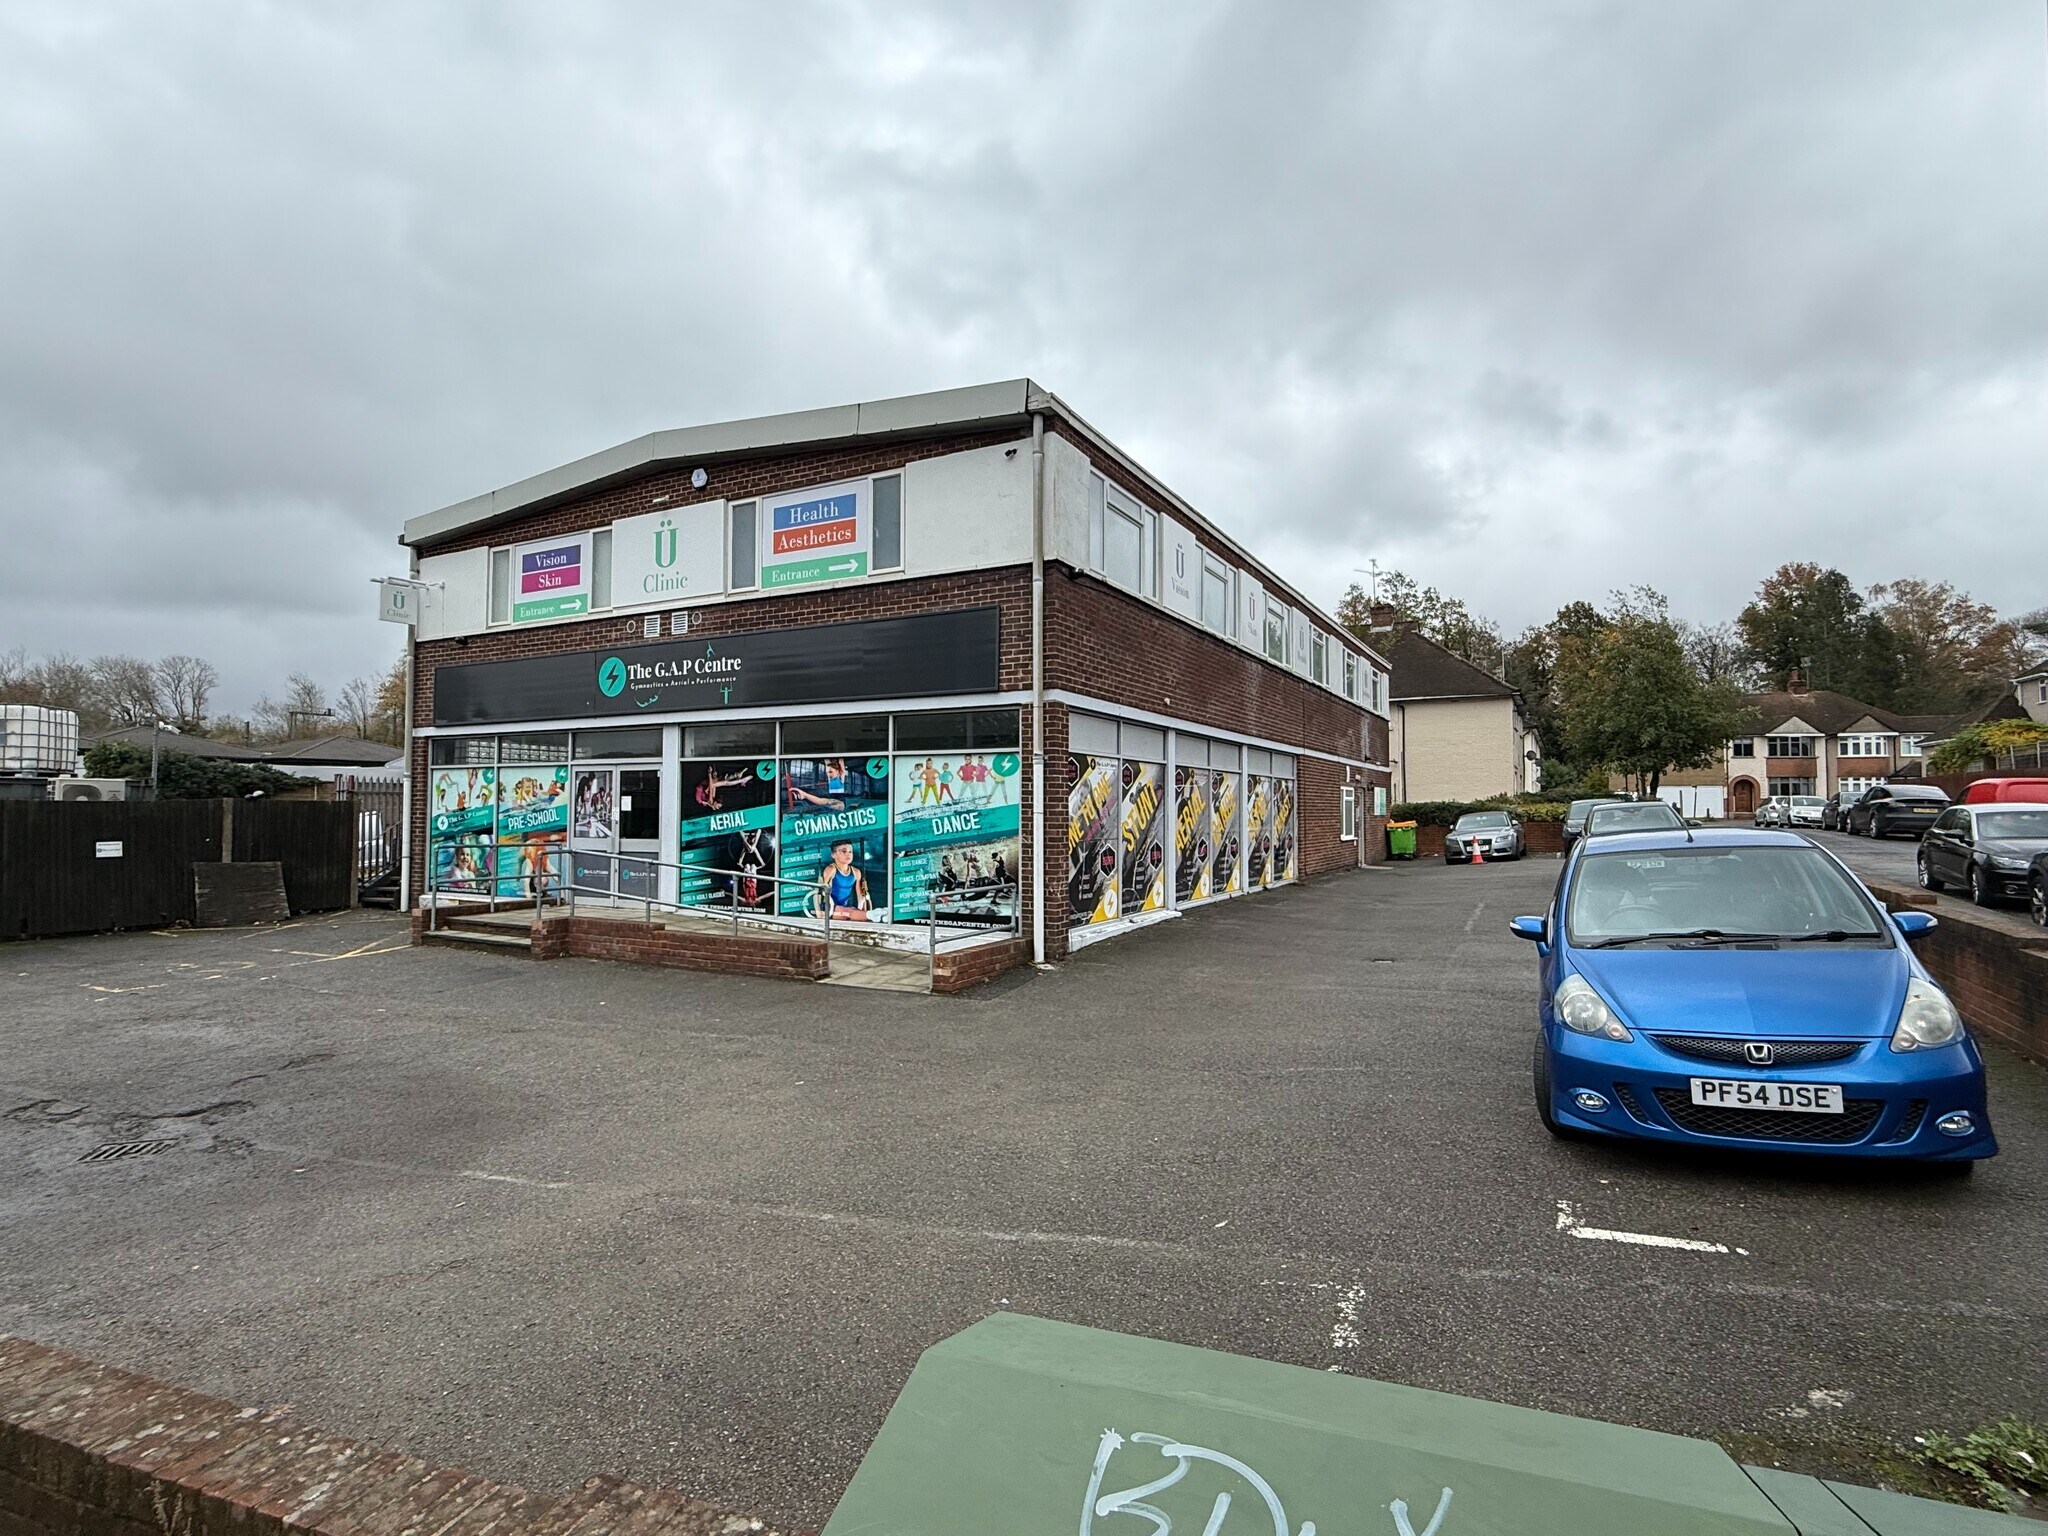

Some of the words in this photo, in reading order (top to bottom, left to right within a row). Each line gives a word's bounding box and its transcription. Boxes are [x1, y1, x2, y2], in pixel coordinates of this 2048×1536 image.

[789, 501, 839, 524] Health
[653, 519, 679, 568] Ü
[778, 526, 852, 551] Aesthetics
[535, 553, 567, 568] Vision
[538, 573, 562, 588] Skin
[643, 571, 688, 594] Clinic
[772, 569, 820, 582] Entrance
[520, 607, 555, 618] Entrance
[628, 663, 653, 680] The
[655, 660, 692, 677] G.A.P
[695, 656, 742, 674] Centre
[630, 682, 664, 691] Gymnastics
[671, 678, 690, 686] Aerial
[696, 676, 737, 685] Performance
[508, 808, 560, 830] PRE-SCHOOL
[710, 812, 749, 832] AERIAL
[794, 808, 877, 836] GYMNASTICS
[1080, 795, 1096, 826] TO
[1121, 777, 1158, 852] STUNT
[931, 812, 981, 836] DANCE
[1701, 1081, 1770, 1105] PF54
[1777, 1086, 1831, 1108] DSE
